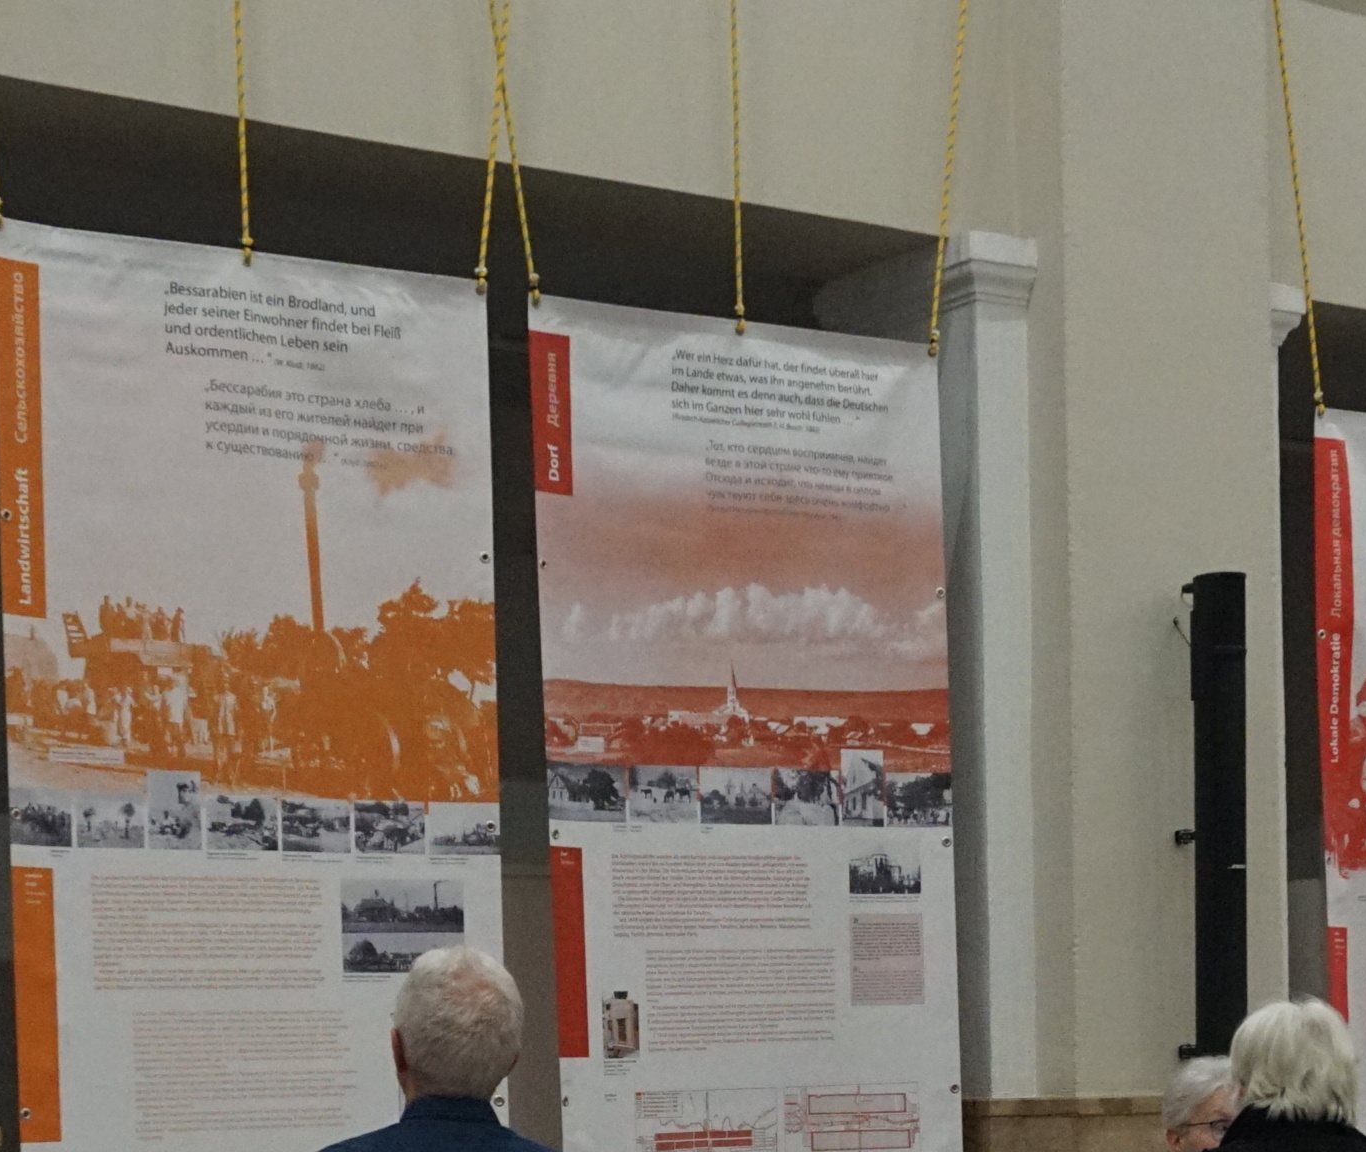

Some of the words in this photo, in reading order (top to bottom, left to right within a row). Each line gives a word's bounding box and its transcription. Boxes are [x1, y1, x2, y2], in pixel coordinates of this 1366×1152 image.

[250, 290, 263, 304] ist
[266, 293, 284, 307] ein
[288, 295, 347, 316] Brodland,
[351, 303, 375, 317] und
[164, 302, 196, 318] jeder
[202, 306, 239, 320] seiner
[244, 308, 307, 329] Einwohner
[312, 316, 347, 334] findet
[352, 321, 370, 336] bei
[374, 324, 401, 340] Fleiß
[165, 321, 191, 335] und
[195, 324, 277, 345] ordentlichem
[281, 332, 319, 350] Leben
[323, 340, 348, 353] sein
[12, 271, 27, 444] Сельскохозяйство
[165, 340, 248, 361] Auskommen
[697, 352, 711, 363] ein
[713, 352, 733, 366] Herz
[783, 360, 798, 373] der
[801, 362, 826, 376] findet
[547, 351, 560, 428] Деревня
[672, 364, 683, 376] im
[686, 365, 714, 379] Lande
[749, 375, 767, 385] was
[770, 375, 784, 386] ihn
[787, 378, 835, 391] angenehm
[285, 391, 304, 403] это
[308, 394, 351, 409] страна
[355, 397, 391, 411] хлеба
[671, 381, 698, 394] Daher
[701, 383, 735, 398] kommt
[737, 390, 748, 399] es
[751, 388, 776, 402] denn
[826, 396, 841, 408] die
[842, 397, 888, 414] Deutschen
[672, 398, 689, 410] sich
[692, 400, 703, 411] im
[706, 400, 741, 415] Ganzen
[744, 404, 763, 416] hier
[766, 406, 785, 418] sehr
[787, 409, 810, 421] wohl
[205, 401, 256, 416] каждый
[259, 407, 272, 418] из
[276, 409, 293, 421] его
[297, 411, 350, 427] жителей
[354, 416, 396, 432] найдет
[400, 422, 423, 436] при
[273, 427, 347, 445] порядочной
[547, 443, 560, 482] Dorf
[1329, 448, 1342, 536] демократия
[16, 467, 32, 605] Landwirtschaft
[1330, 632, 1341, 714] Demokratie
[1330, 717, 1340, 763] Lokale
